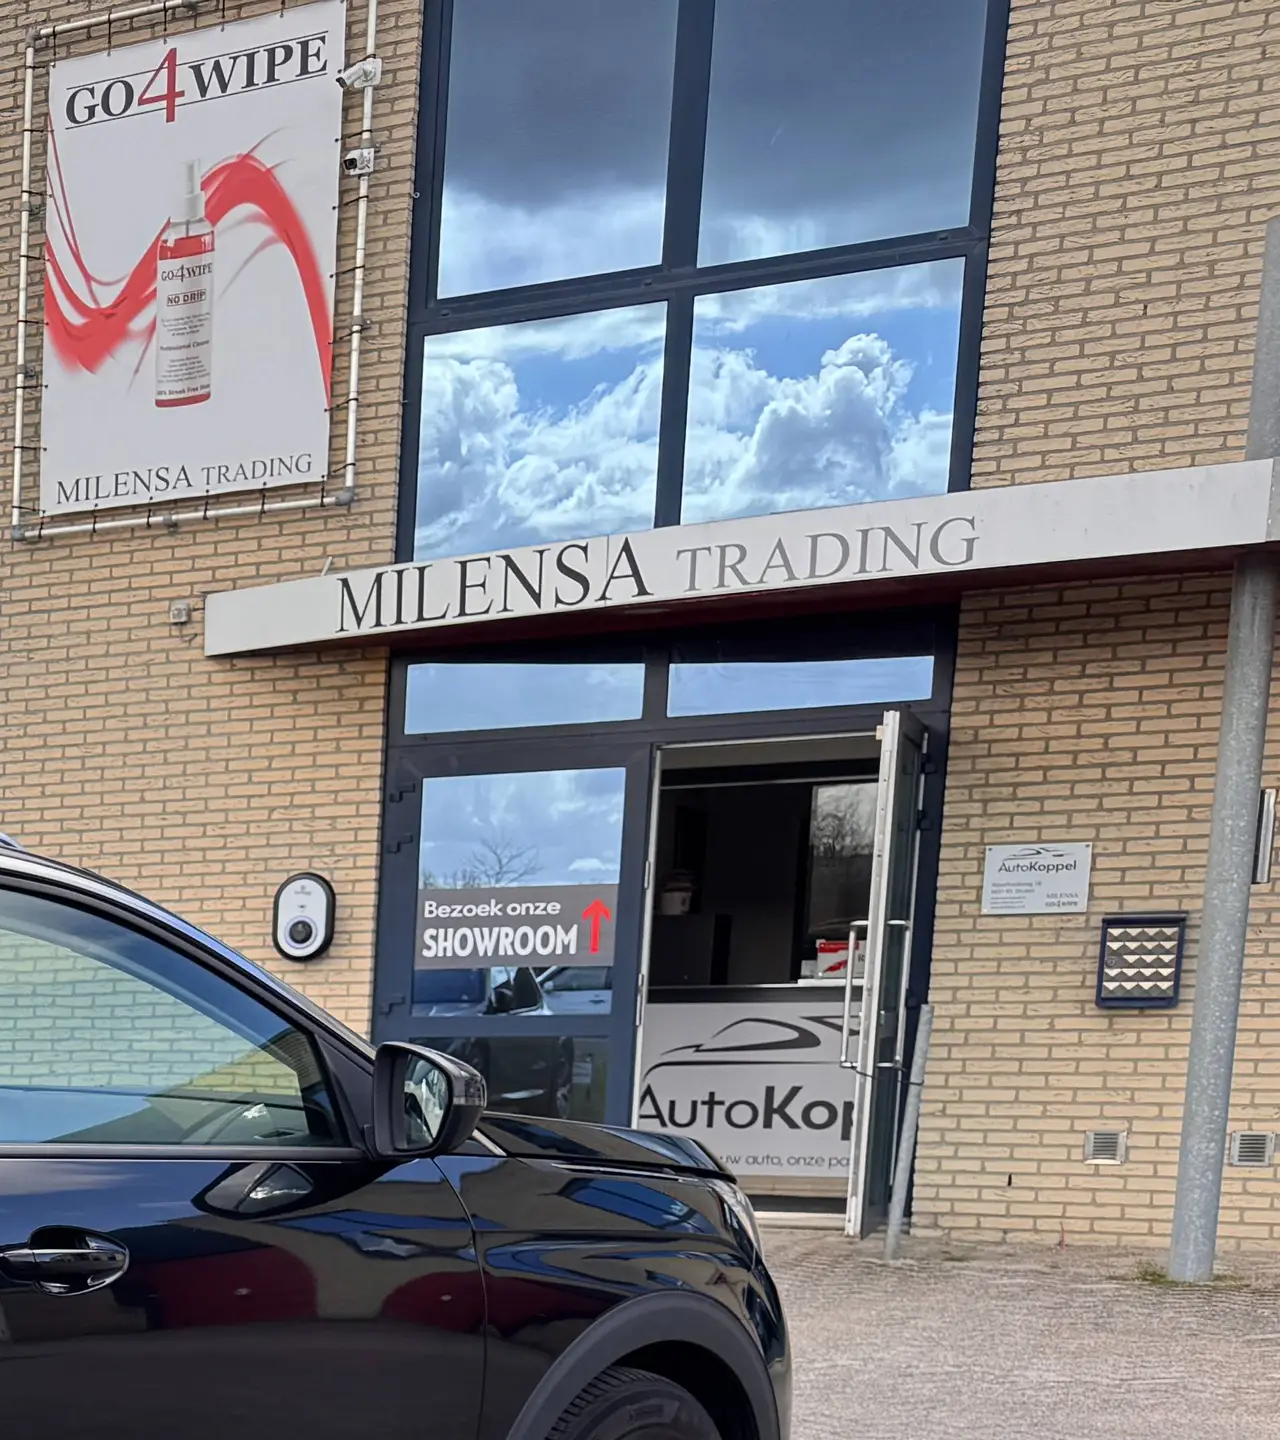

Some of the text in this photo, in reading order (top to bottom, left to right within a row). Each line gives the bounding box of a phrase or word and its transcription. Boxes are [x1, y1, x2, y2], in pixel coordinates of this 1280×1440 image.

[65, 35, 328, 123] GO4WIPE
[167, 290, 206, 305] NO DRIP
[55, 453, 313, 505] MILENSA TRADING
[335, 516, 980, 634] MILENSA TRADING
[997, 860, 1077, 873] AutoKoppel
[424, 898, 561, 918] Bezoek onze
[422, 924, 578, 957] SHOWROOM
[787, 1155, 826, 1166] onze
